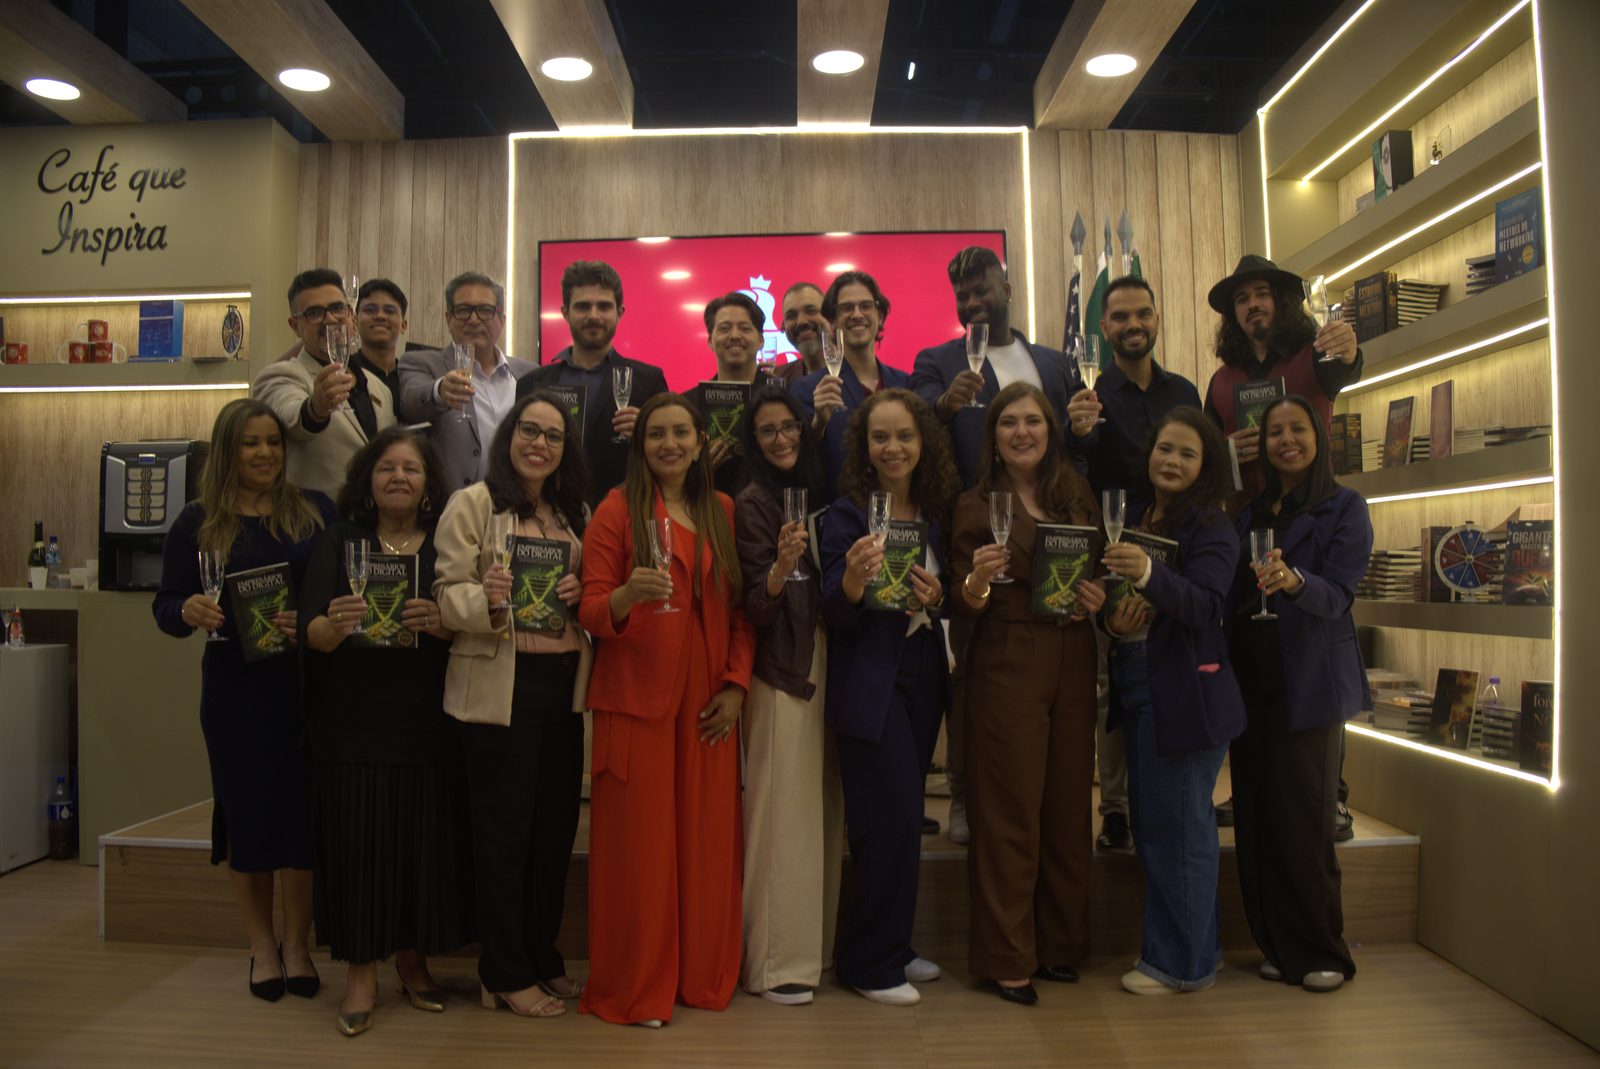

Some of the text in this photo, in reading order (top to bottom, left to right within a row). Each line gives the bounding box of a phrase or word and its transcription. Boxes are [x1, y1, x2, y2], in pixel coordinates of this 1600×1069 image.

[37, 145, 187, 204] Café que
[42, 201, 167, 266] Inspira
[1512, 531, 1552, 545] GIGANTE
